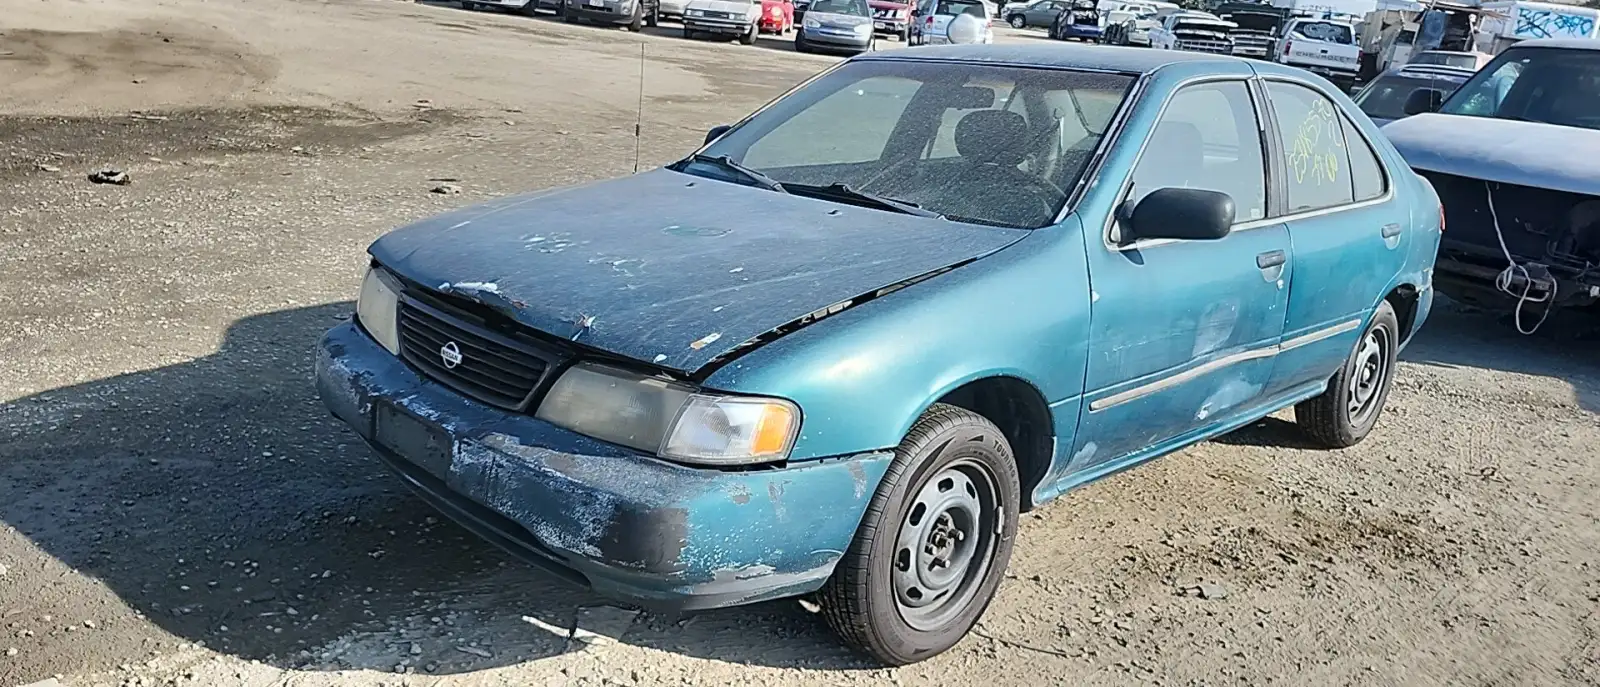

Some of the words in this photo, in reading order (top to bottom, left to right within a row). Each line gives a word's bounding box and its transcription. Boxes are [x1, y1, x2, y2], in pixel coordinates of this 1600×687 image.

[1296, 51, 1352, 62] CHEVROLET
[442, 348, 459, 361] NISSAN
[993, 440, 1016, 478] TOURING
